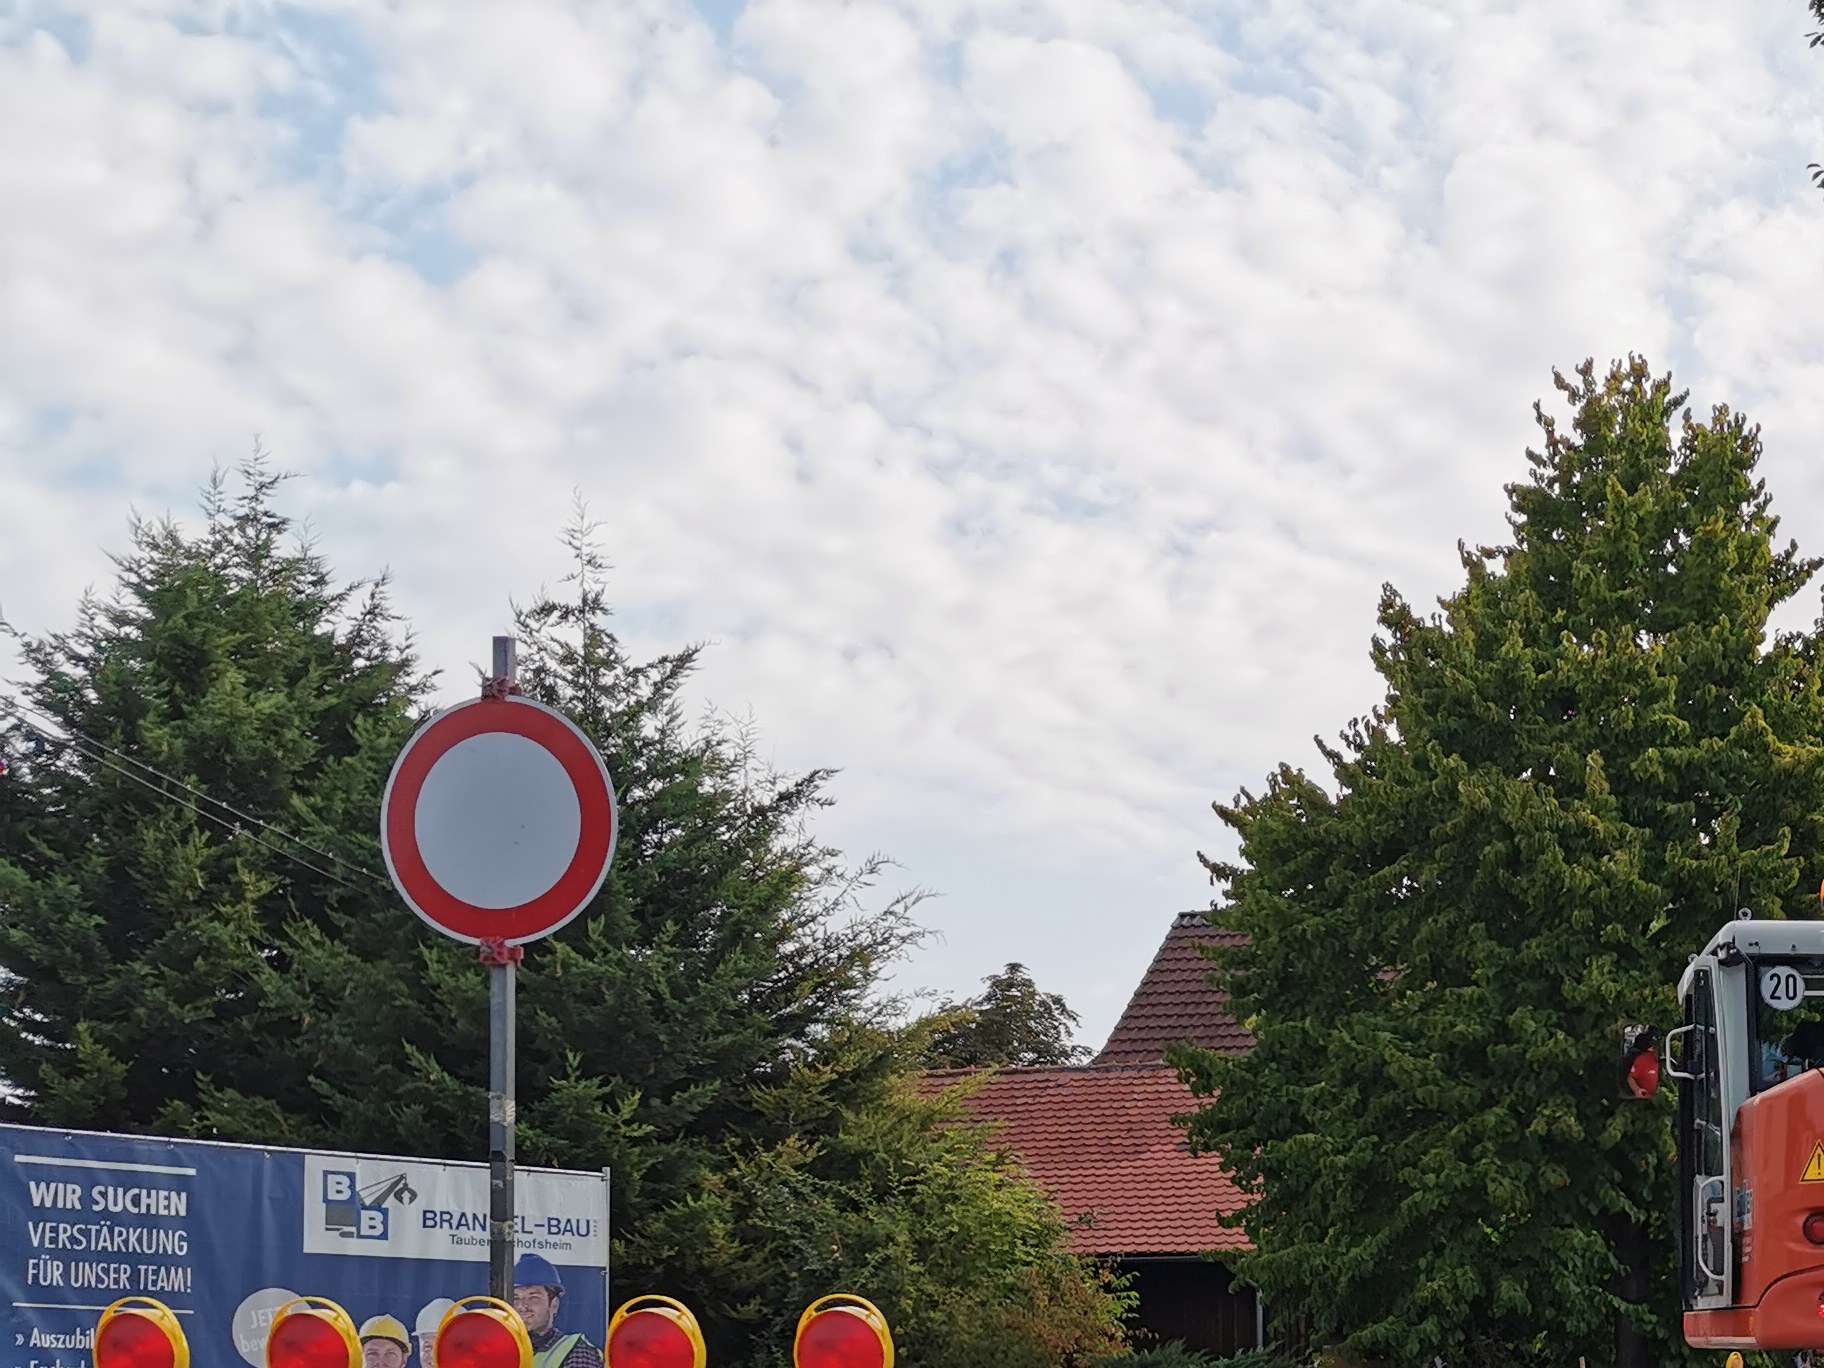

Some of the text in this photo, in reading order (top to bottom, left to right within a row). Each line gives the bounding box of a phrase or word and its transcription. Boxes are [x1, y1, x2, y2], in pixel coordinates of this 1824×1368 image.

[1769, 972, 1798, 1001] 20
[29, 1180, 187, 1217] WIR SUCHEN
[326, 1174, 352, 1201] B
[360, 1210, 384, 1236] B
[27, 1220, 188, 1256] VERSTÄRKUNG
[27, 1254, 192, 1293] FÜR UNSER TEAM!
[250, 1306, 281, 1329] JET
